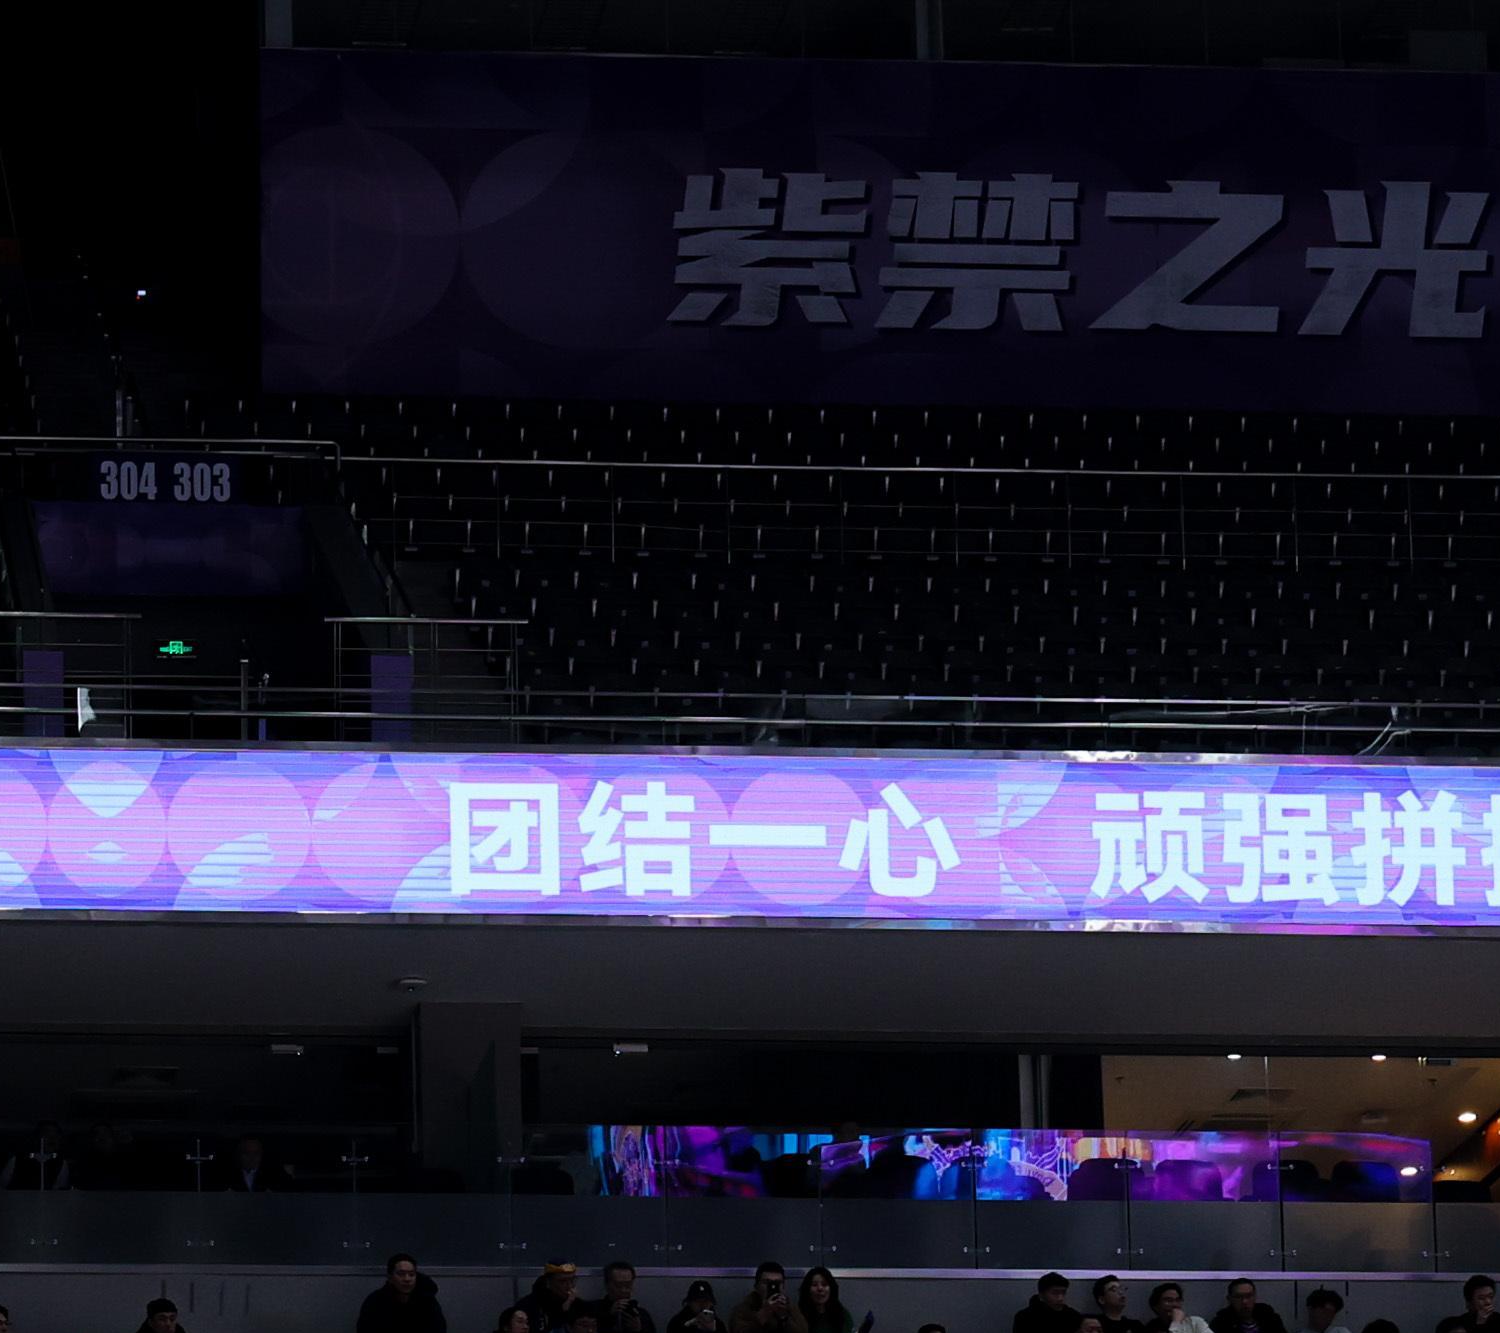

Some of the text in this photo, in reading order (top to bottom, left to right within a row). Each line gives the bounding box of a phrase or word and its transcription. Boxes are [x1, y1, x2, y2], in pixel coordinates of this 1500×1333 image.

[672, 168, 1494, 342] 紫禁之光
[99, 460, 232, 504] 304 303
[447, 780, 961, 902] 团结一心
